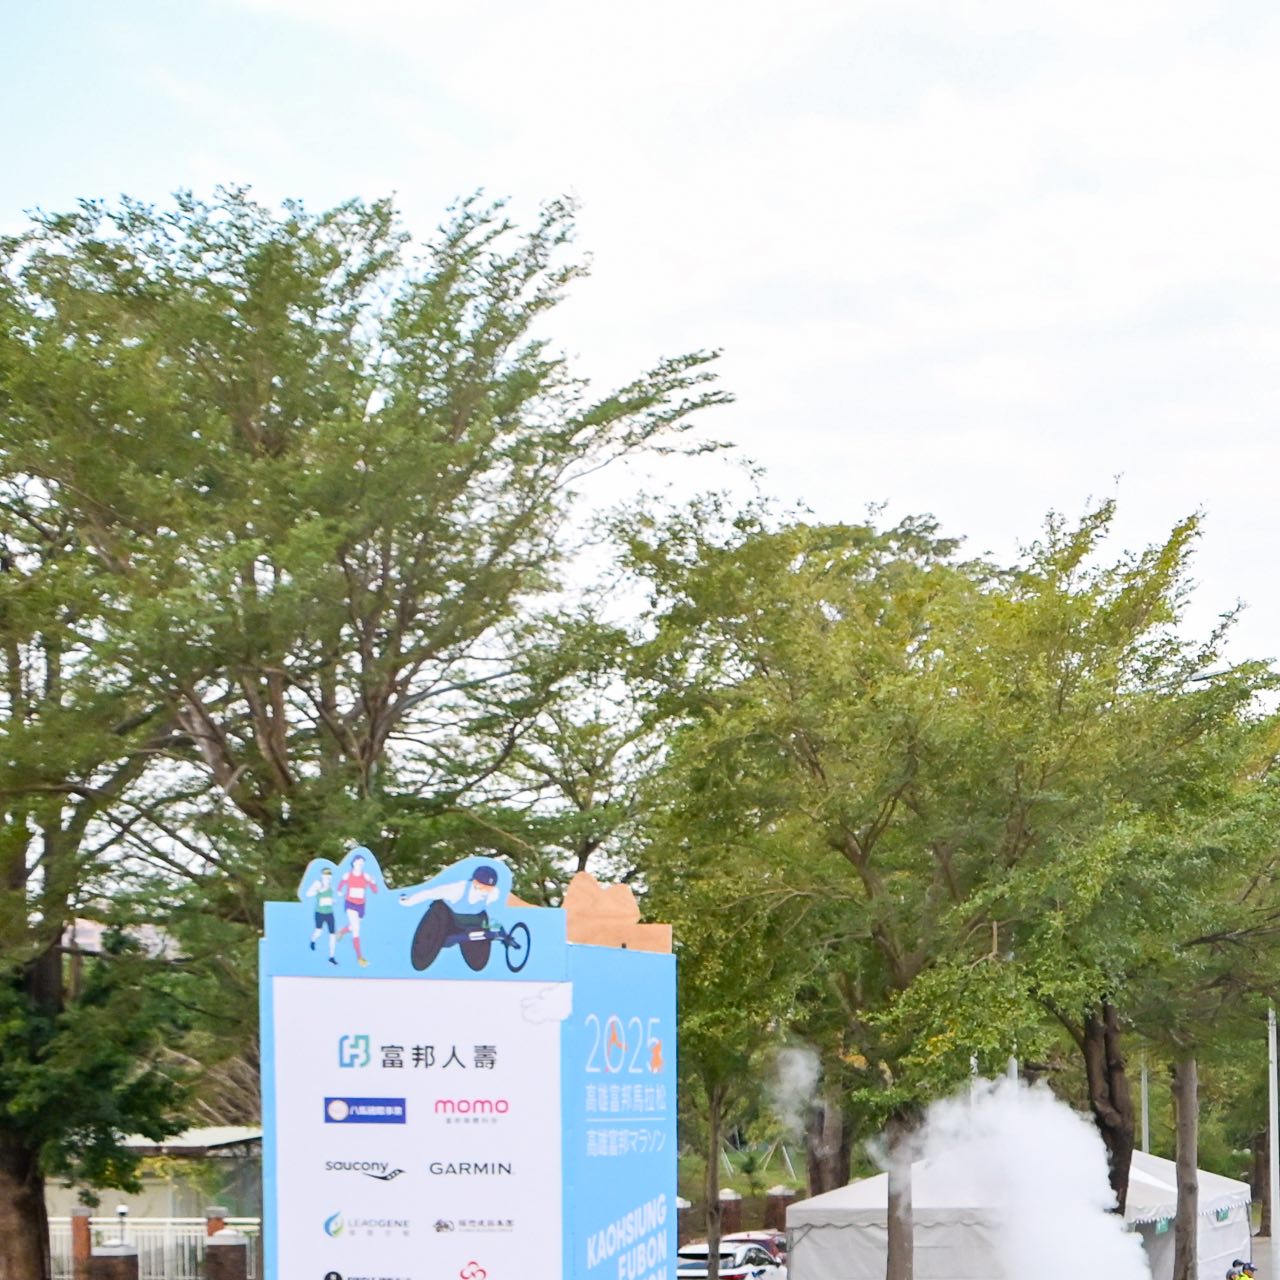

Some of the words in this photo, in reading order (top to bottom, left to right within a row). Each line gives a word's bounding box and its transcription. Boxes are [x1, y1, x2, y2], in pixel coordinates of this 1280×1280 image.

[381, 1045, 497, 1069] 富邦人壽
[434, 1099, 509, 1114] momo
[326, 1160, 388, 1173] saucony
[430, 1162, 512, 1175] GARMIN
[586, 1193, 667, 1270] KAOHSIUNG
